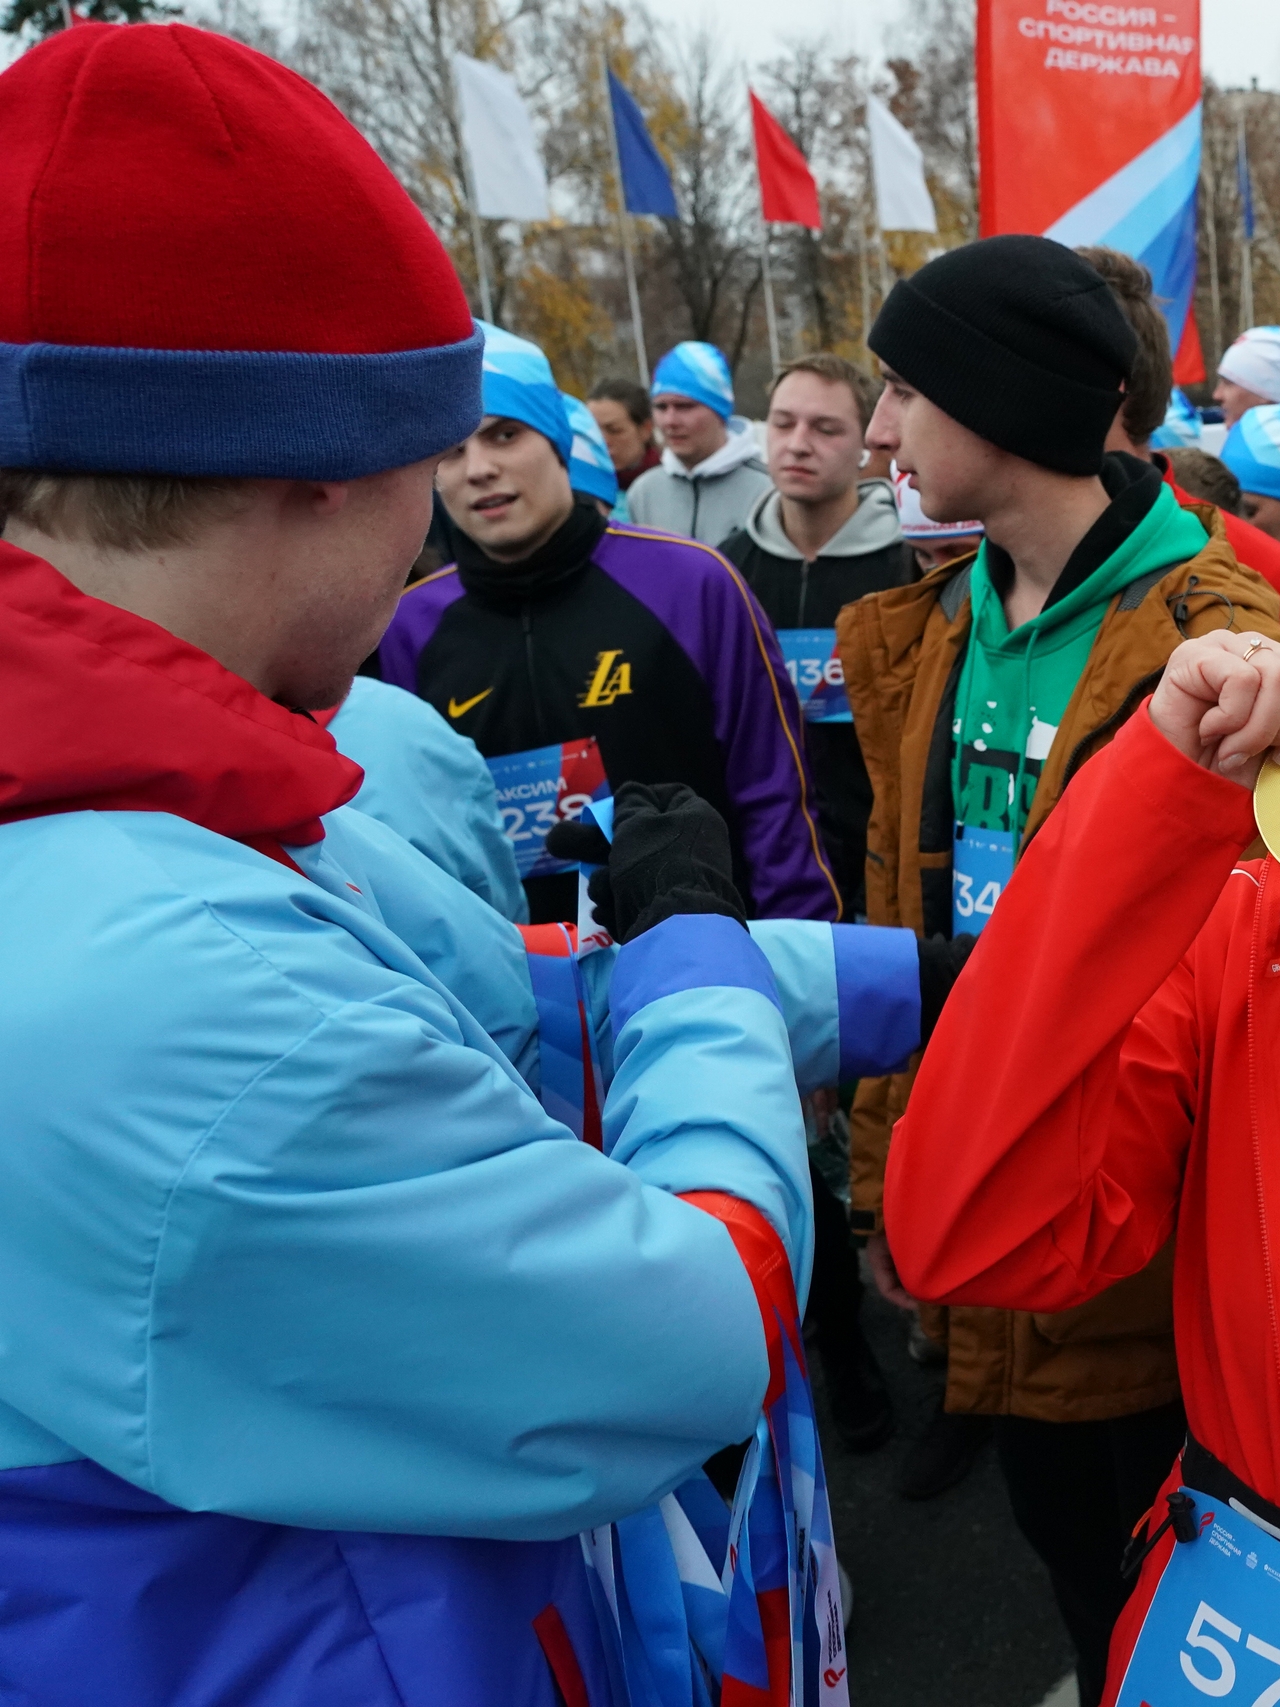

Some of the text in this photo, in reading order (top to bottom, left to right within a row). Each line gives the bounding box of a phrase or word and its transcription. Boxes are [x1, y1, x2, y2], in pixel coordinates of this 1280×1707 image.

[1047, 0, 1156, 26] РОССИЯ
[1018, 18, 1194, 54] СПОРТИВНАЯ
[1045, 47, 1179, 77] ДЕРЖАВА
[496, 776, 568, 802] АКСИМ
[953, 868, 1002, 917] 34
